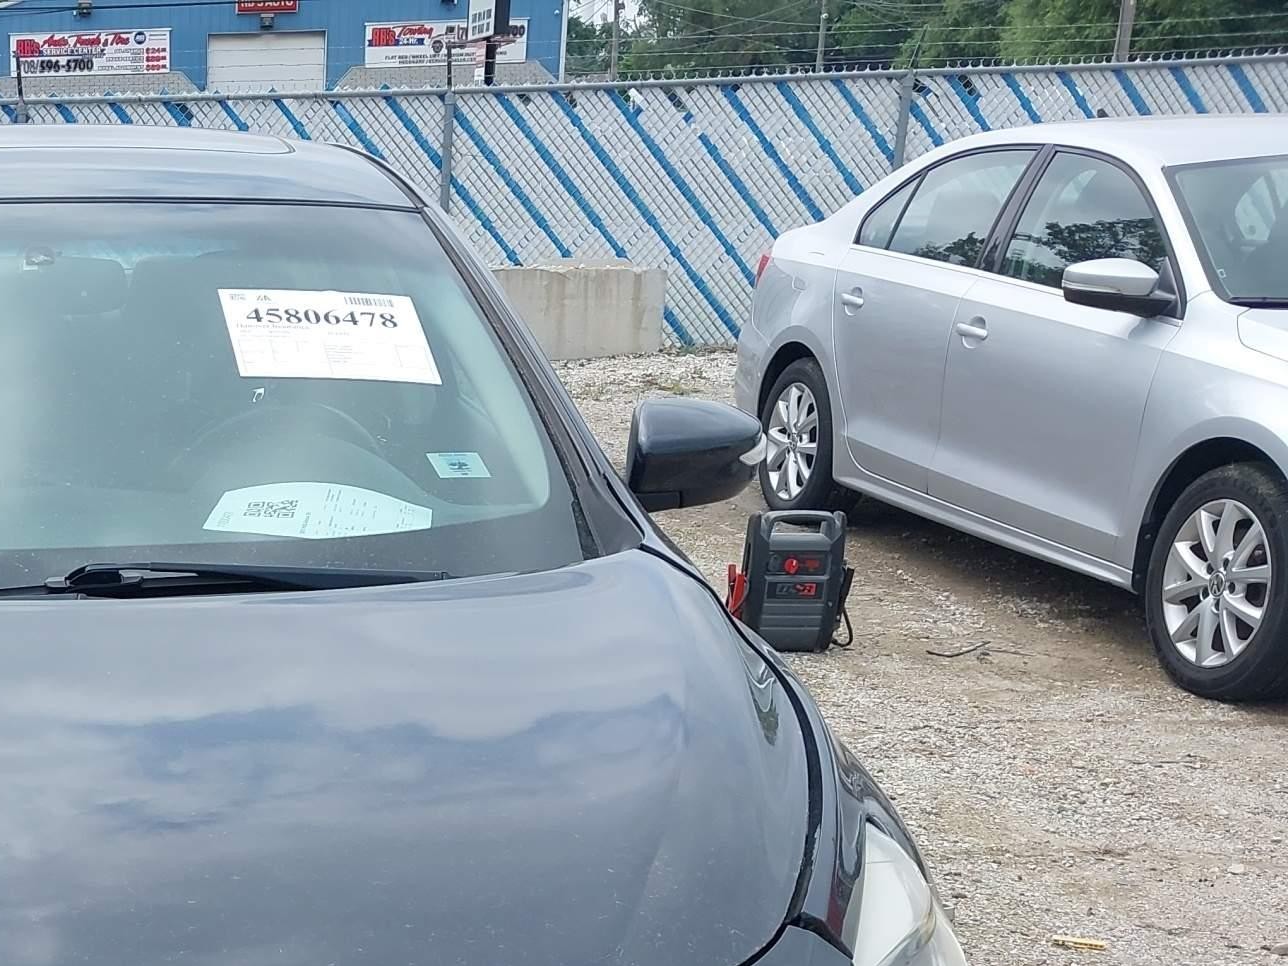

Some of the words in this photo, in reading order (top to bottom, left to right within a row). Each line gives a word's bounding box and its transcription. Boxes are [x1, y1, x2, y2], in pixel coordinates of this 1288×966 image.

[42, 47, 72, 56] SERVICE
[73, 46, 102, 55] CENTER
[245, 307, 399, 329] 45806478
